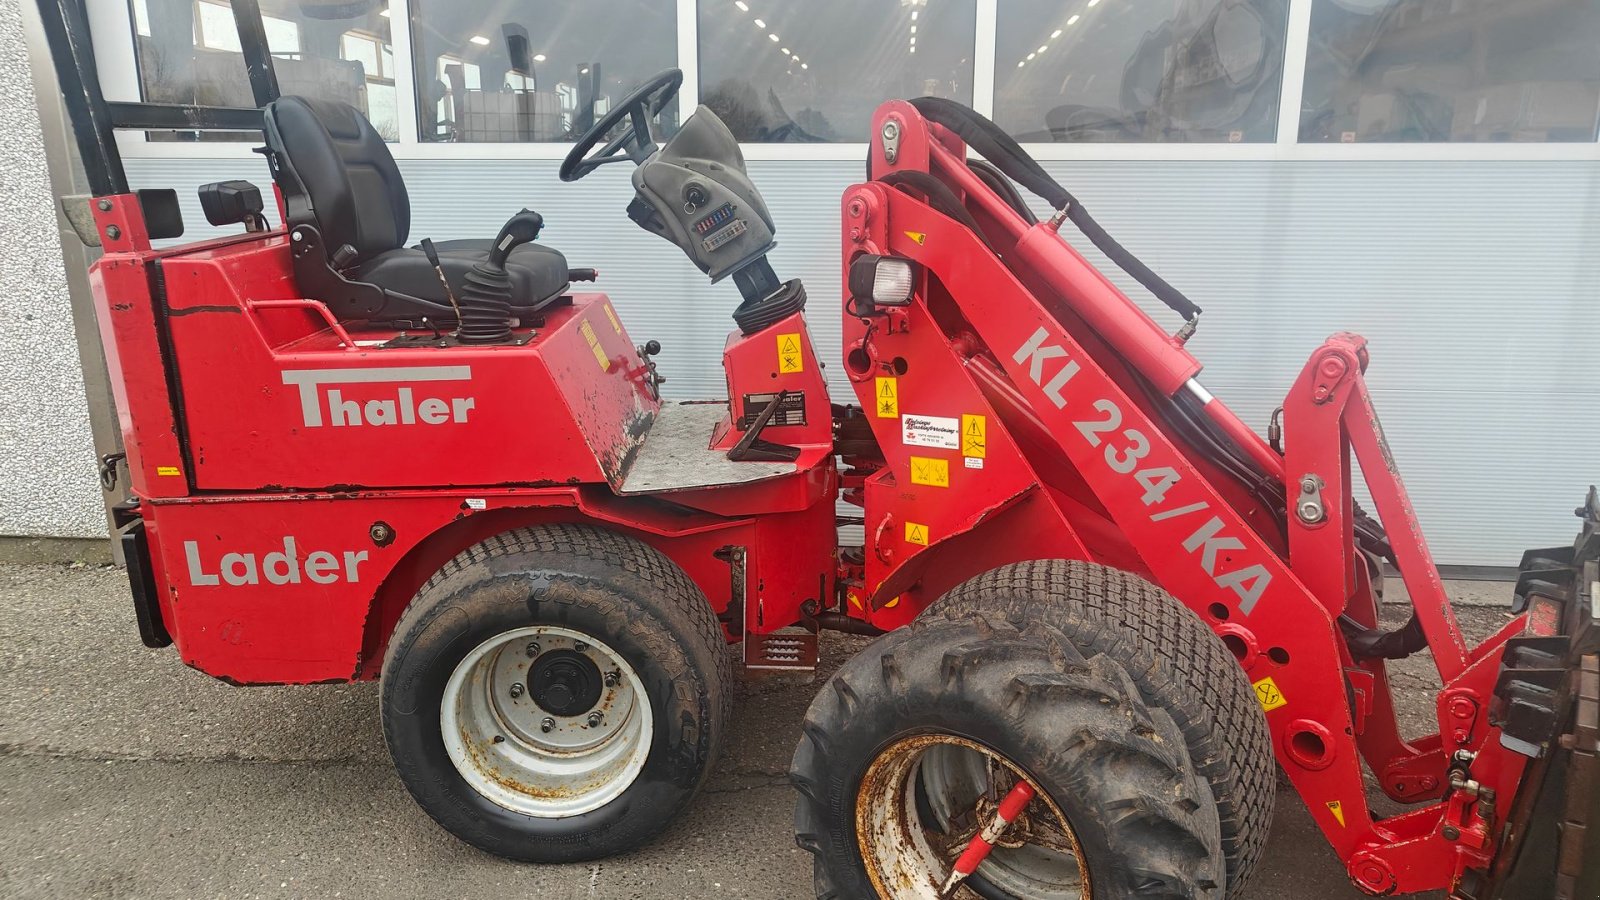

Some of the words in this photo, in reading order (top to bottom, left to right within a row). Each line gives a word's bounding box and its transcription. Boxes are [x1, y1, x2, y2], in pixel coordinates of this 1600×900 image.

[281, 365, 475, 428] Thaler
[1012, 326, 1081, 410] KL
[1072, 399, 1273, 617] 234/KA
[183, 535, 370, 587] Lader
